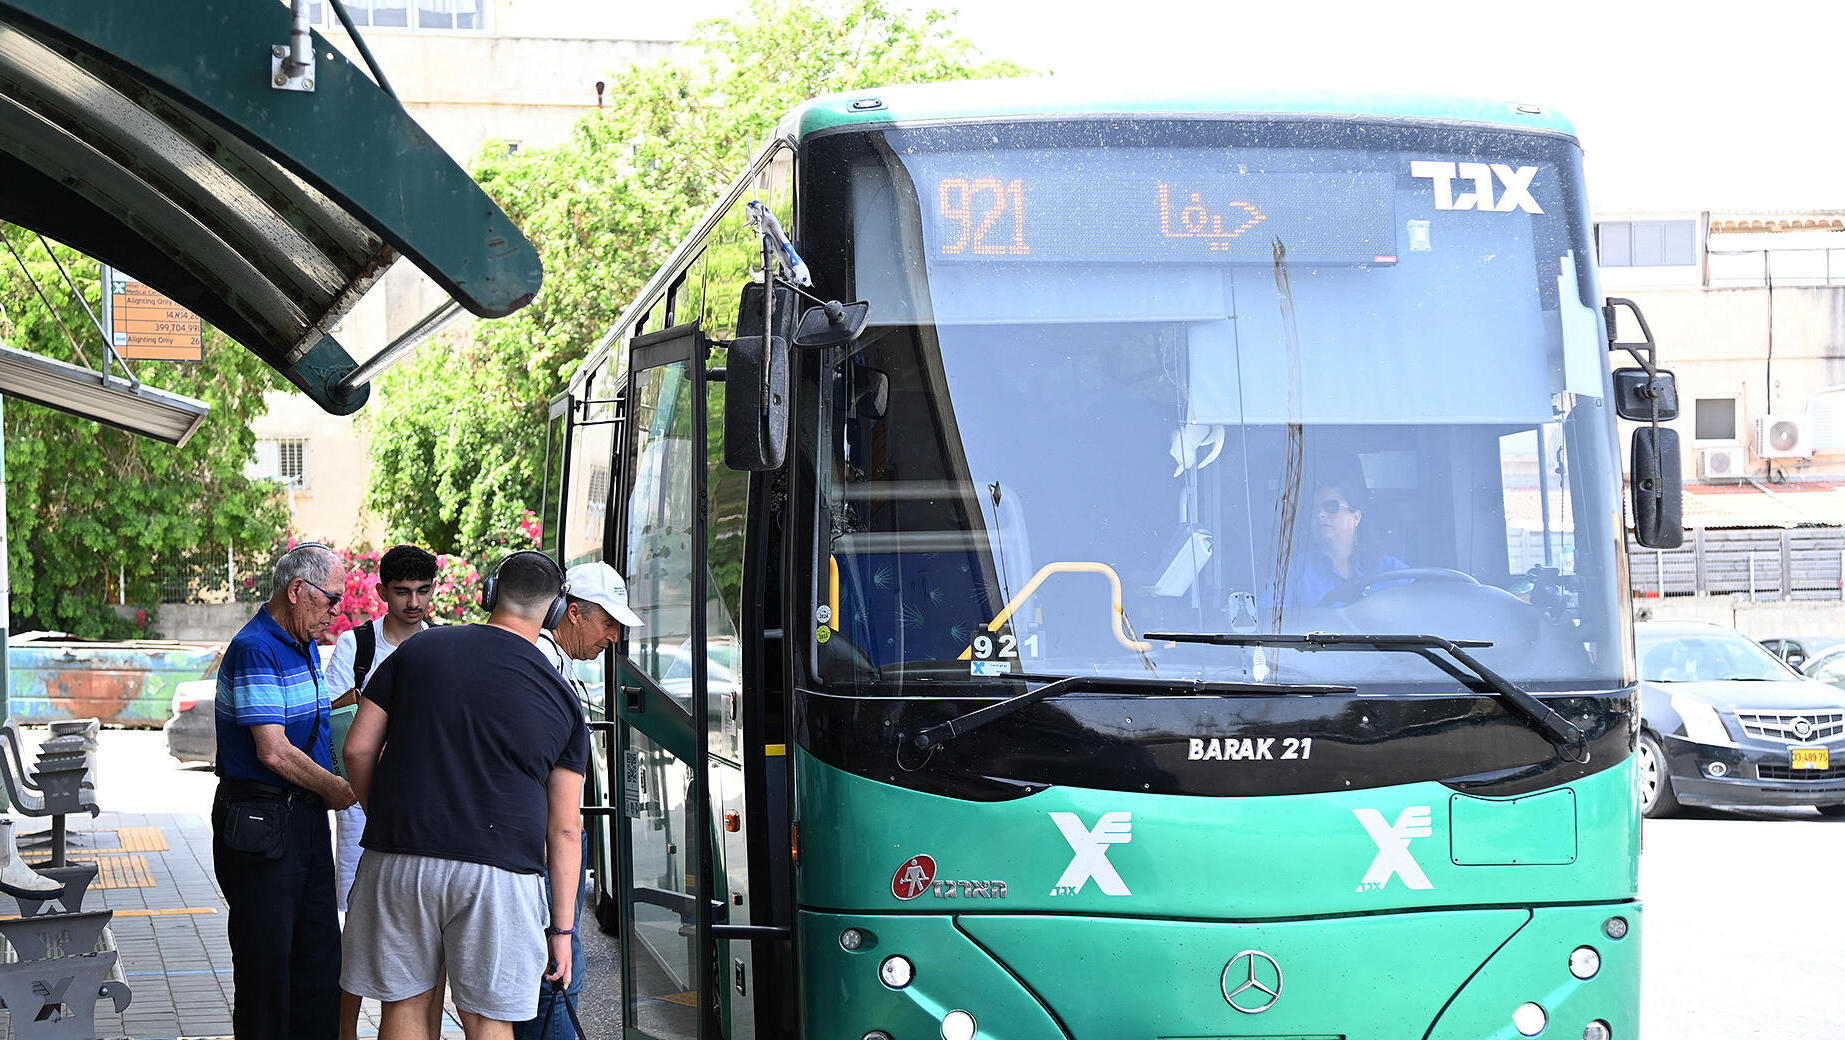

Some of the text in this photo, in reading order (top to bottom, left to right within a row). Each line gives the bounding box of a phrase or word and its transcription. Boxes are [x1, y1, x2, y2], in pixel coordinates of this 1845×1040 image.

[1410, 161, 1545, 215] אגד
[939, 177, 1032, 256] 921
[1155, 180, 1268, 251] حيفا
[127, 297, 156, 305] Alighting
[127, 336, 157, 344] Alighting
[190, 337, 200, 345] 26
[973, 634, 1039, 659] 921
[1188, 737, 1312, 760] BARAK 21
